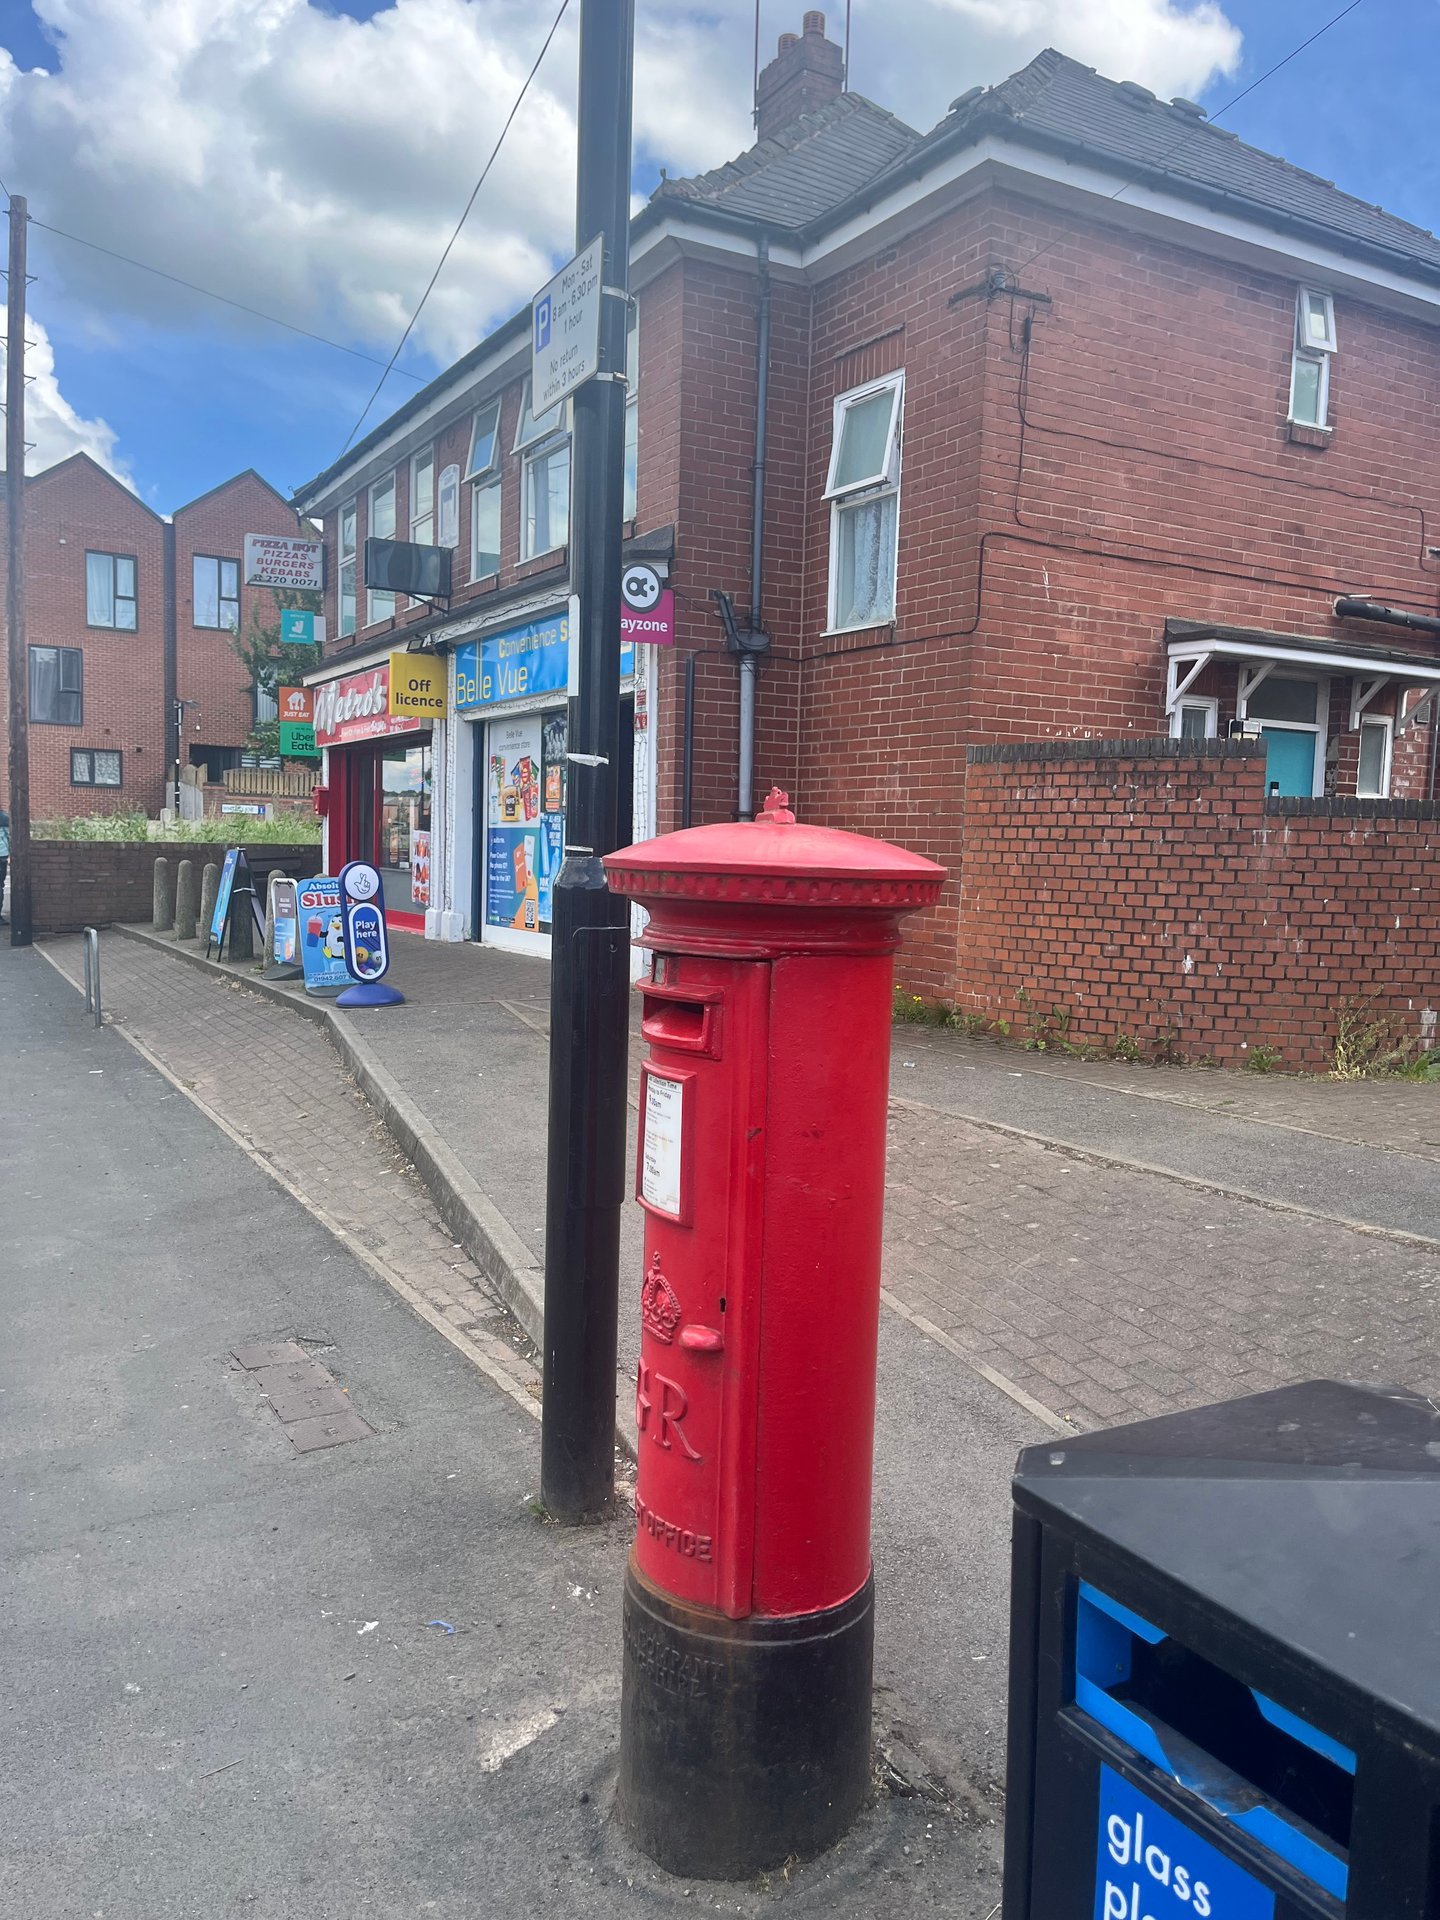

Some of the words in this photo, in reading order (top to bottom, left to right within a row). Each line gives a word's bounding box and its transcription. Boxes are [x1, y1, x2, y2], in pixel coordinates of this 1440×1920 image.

[562, 273, 575, 294] Mon
[581, 254, 593, 276] Sat
[587, 274, 598, 296] pm
[539, 302, 548, 347] P
[569, 309, 584, 330] hour
[550, 360, 558, 376] No
[559, 344, 578, 366] return
[543, 379, 560, 402] within
[562, 372, 567, 387] 3
[568, 360, 585, 383] hours
[252, 539, 288, 550] PIZZA
[256, 557, 314, 569] BURGERS
[263, 549, 308, 560] PIZZAS
[261, 566, 310, 578] KEBABS
[265, 575, 287, 584] 270
[291, 577, 318, 587] 0071
[621, 617, 668, 634] ayzone
[498, 628, 557, 659] Convenience
[457, 637, 492, 705] Belle
[497, 661, 528, 696] Vue
[408, 679, 432, 692] Off
[395, 692, 443, 707] licence
[291, 731, 314, 742] Uber
[291, 741, 315, 751] Eats
[355, 920, 376, 930] Play
[356, 929, 378, 939] here
[647, 1509, 712, 1563] OFFICE
[1106, 1811, 1212, 1918] glass
[1103, 1879, 1157, 1920] pl
